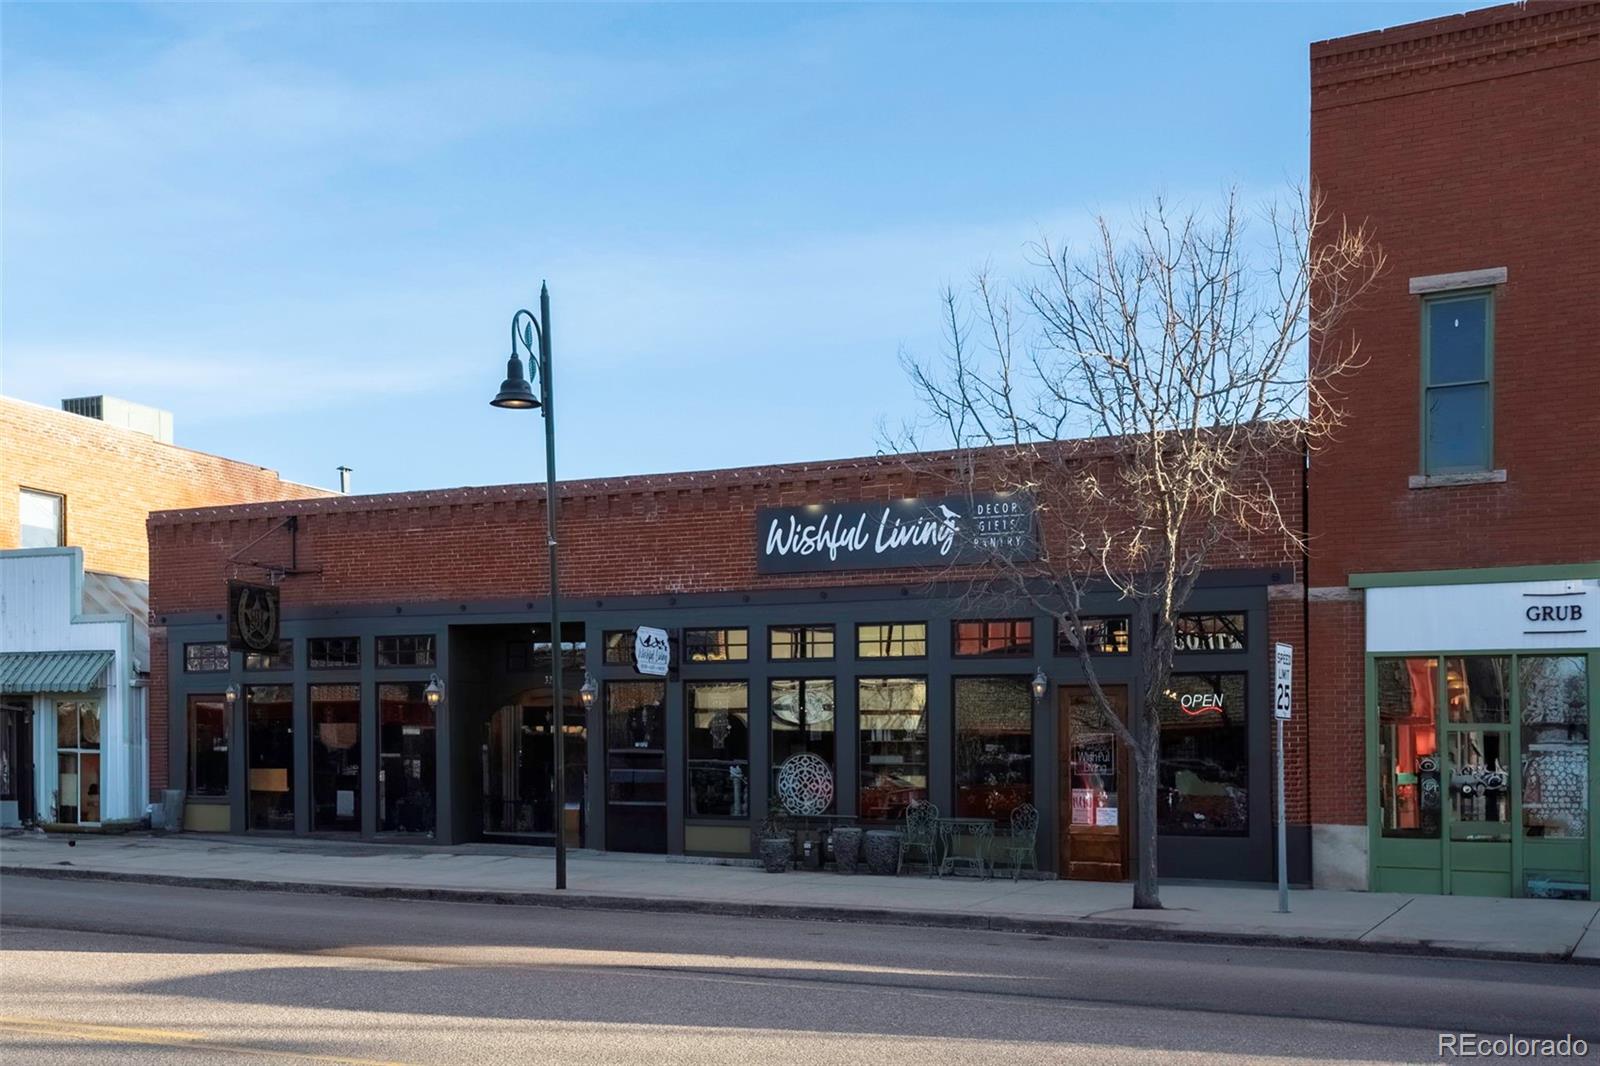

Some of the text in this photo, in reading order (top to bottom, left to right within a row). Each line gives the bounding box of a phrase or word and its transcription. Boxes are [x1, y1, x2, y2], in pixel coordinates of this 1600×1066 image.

[977, 502, 1017, 515] DECOR
[979, 519, 1016, 531] GIFTS
[766, 507, 957, 561] Wishful Living
[1526, 604, 1582, 621] GRUB
[1277, 652, 1291, 665] SPEED
[1278, 668, 1290, 680] LIMIT
[1180, 694, 1224, 708] OPEN
[1277, 683, 1291, 711] 25
